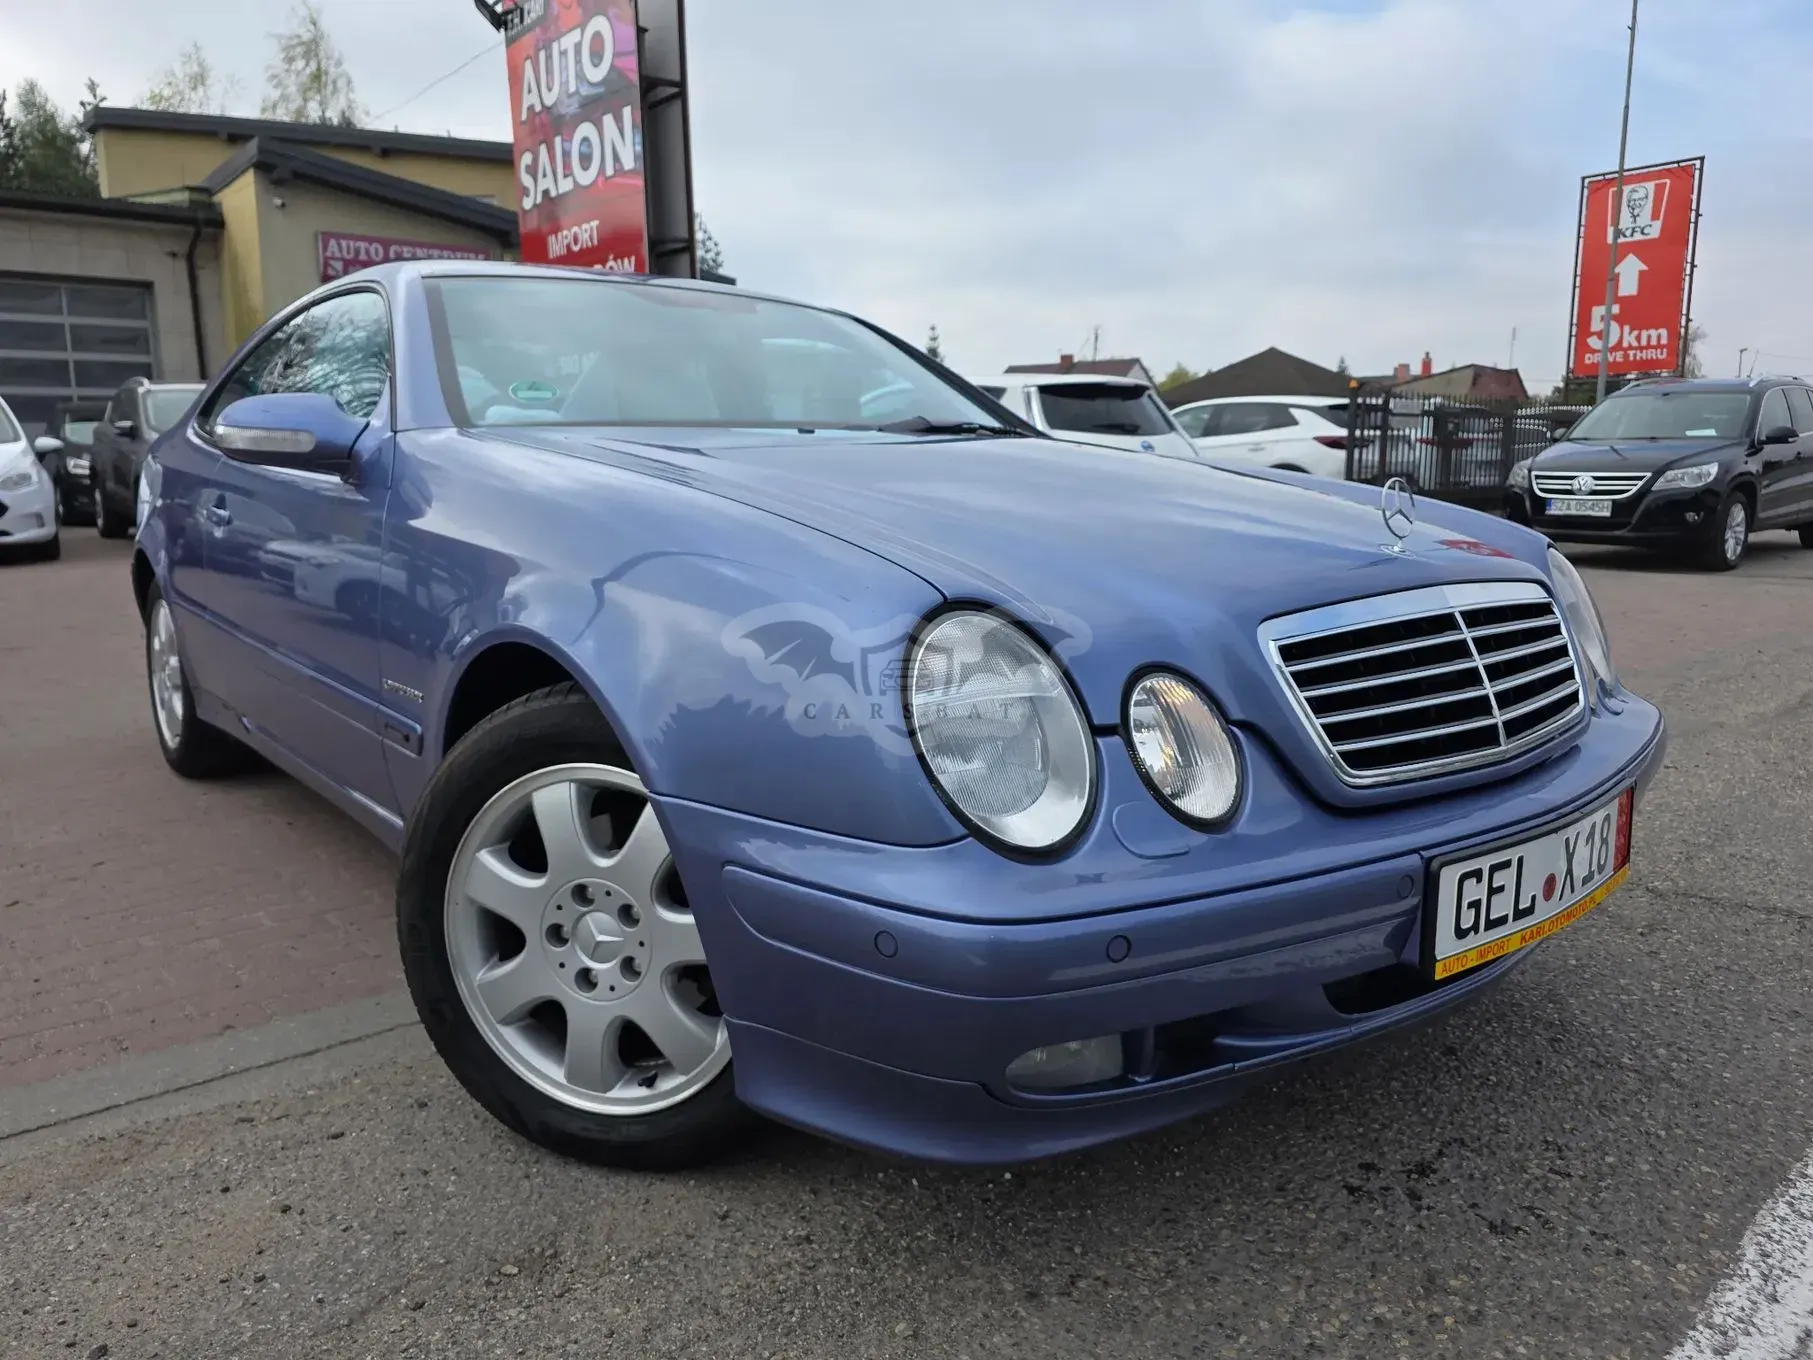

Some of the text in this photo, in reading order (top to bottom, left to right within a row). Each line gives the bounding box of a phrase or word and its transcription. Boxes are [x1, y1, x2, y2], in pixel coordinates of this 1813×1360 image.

[520, 14, 614, 122] AUTO
[519, 105, 635, 211] SALON
[325, 238, 384, 262] AUTO
[546, 219, 600, 259] IMPORT
[1617, 224, 1653, 239] KFC
[592, 253, 635, 273] ÓW
[1586, 303, 1668, 351] 5km
[1584, 347, 1668, 364] DRVE THRU
[1453, 854, 1537, 940] GEL
[1558, 812, 1611, 902] X18
[1440, 955, 1469, 976] AUTO
[1475, 938, 1512, 962] IMPORT
